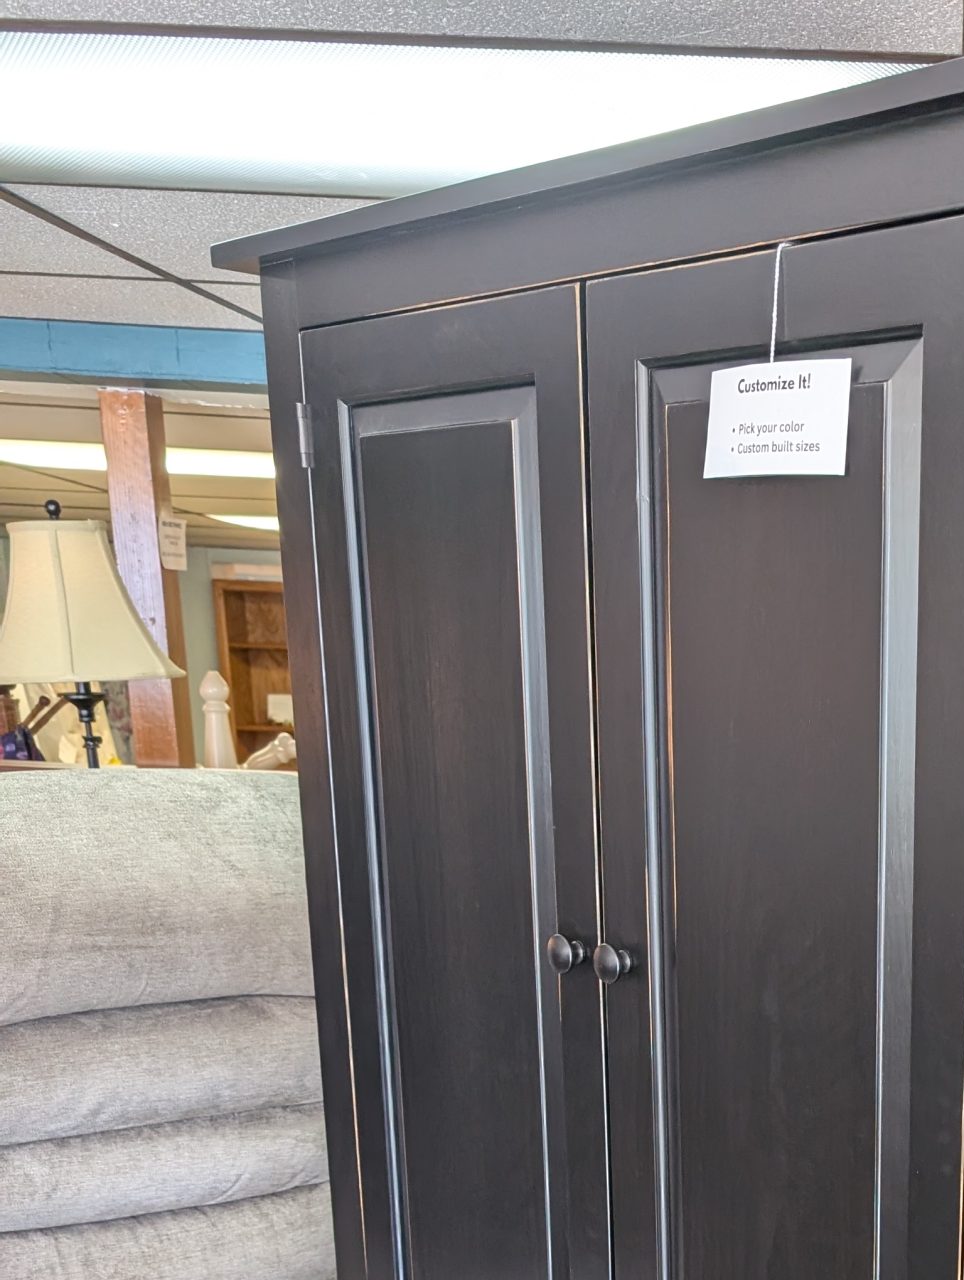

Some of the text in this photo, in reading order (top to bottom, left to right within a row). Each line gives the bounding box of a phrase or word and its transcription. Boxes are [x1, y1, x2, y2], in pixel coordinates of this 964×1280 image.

[737, 373, 811, 394] Customize It!
[738, 420, 805, 437] Pick your color
[737, 440, 820, 454] Custom built sizes
